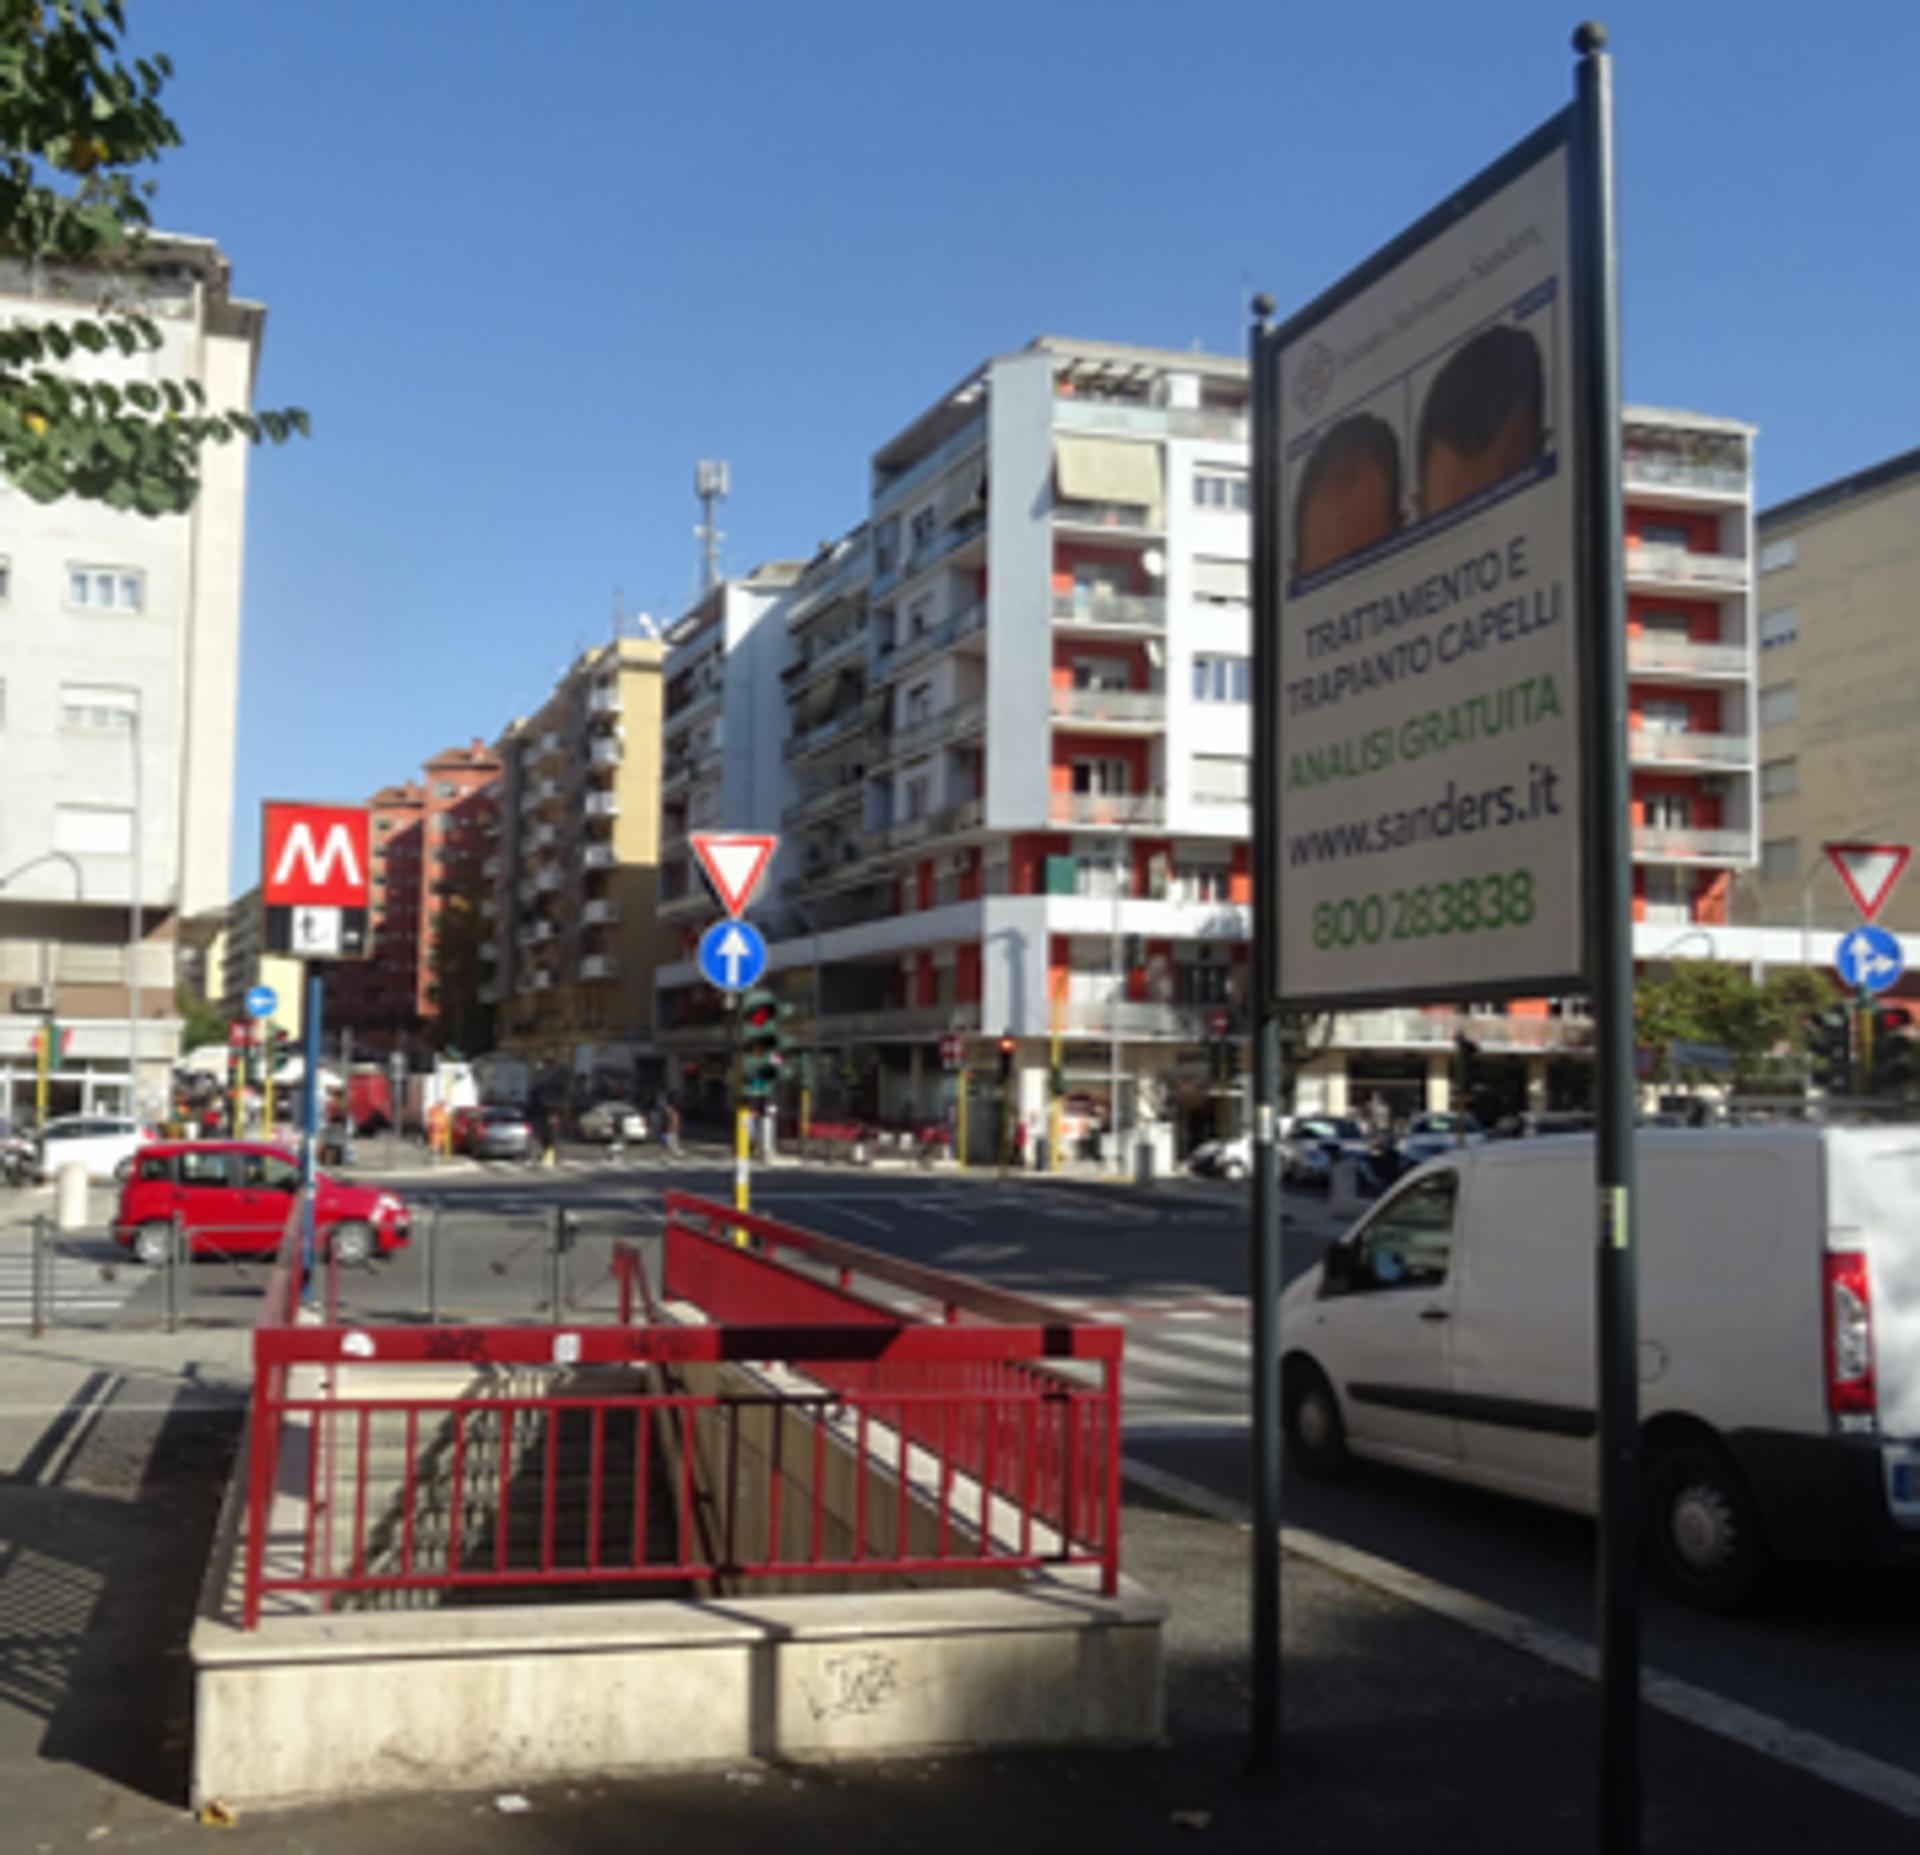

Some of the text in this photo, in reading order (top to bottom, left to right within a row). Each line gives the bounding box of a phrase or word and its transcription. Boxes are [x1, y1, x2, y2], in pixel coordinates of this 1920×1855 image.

[1286, 581, 1563, 716] TRAPIANTO CAPELLI
[1305, 549, 1499, 660] TRATTAMENTO
[1507, 535, 1529, 580] E
[1285, 673, 1563, 791] ANALISI GRATUITA
[271, 821, 365, 887] M
[1287, 762, 1563, 868] www.sanders.it
[1313, 868, 1534, 950] 800 283838
